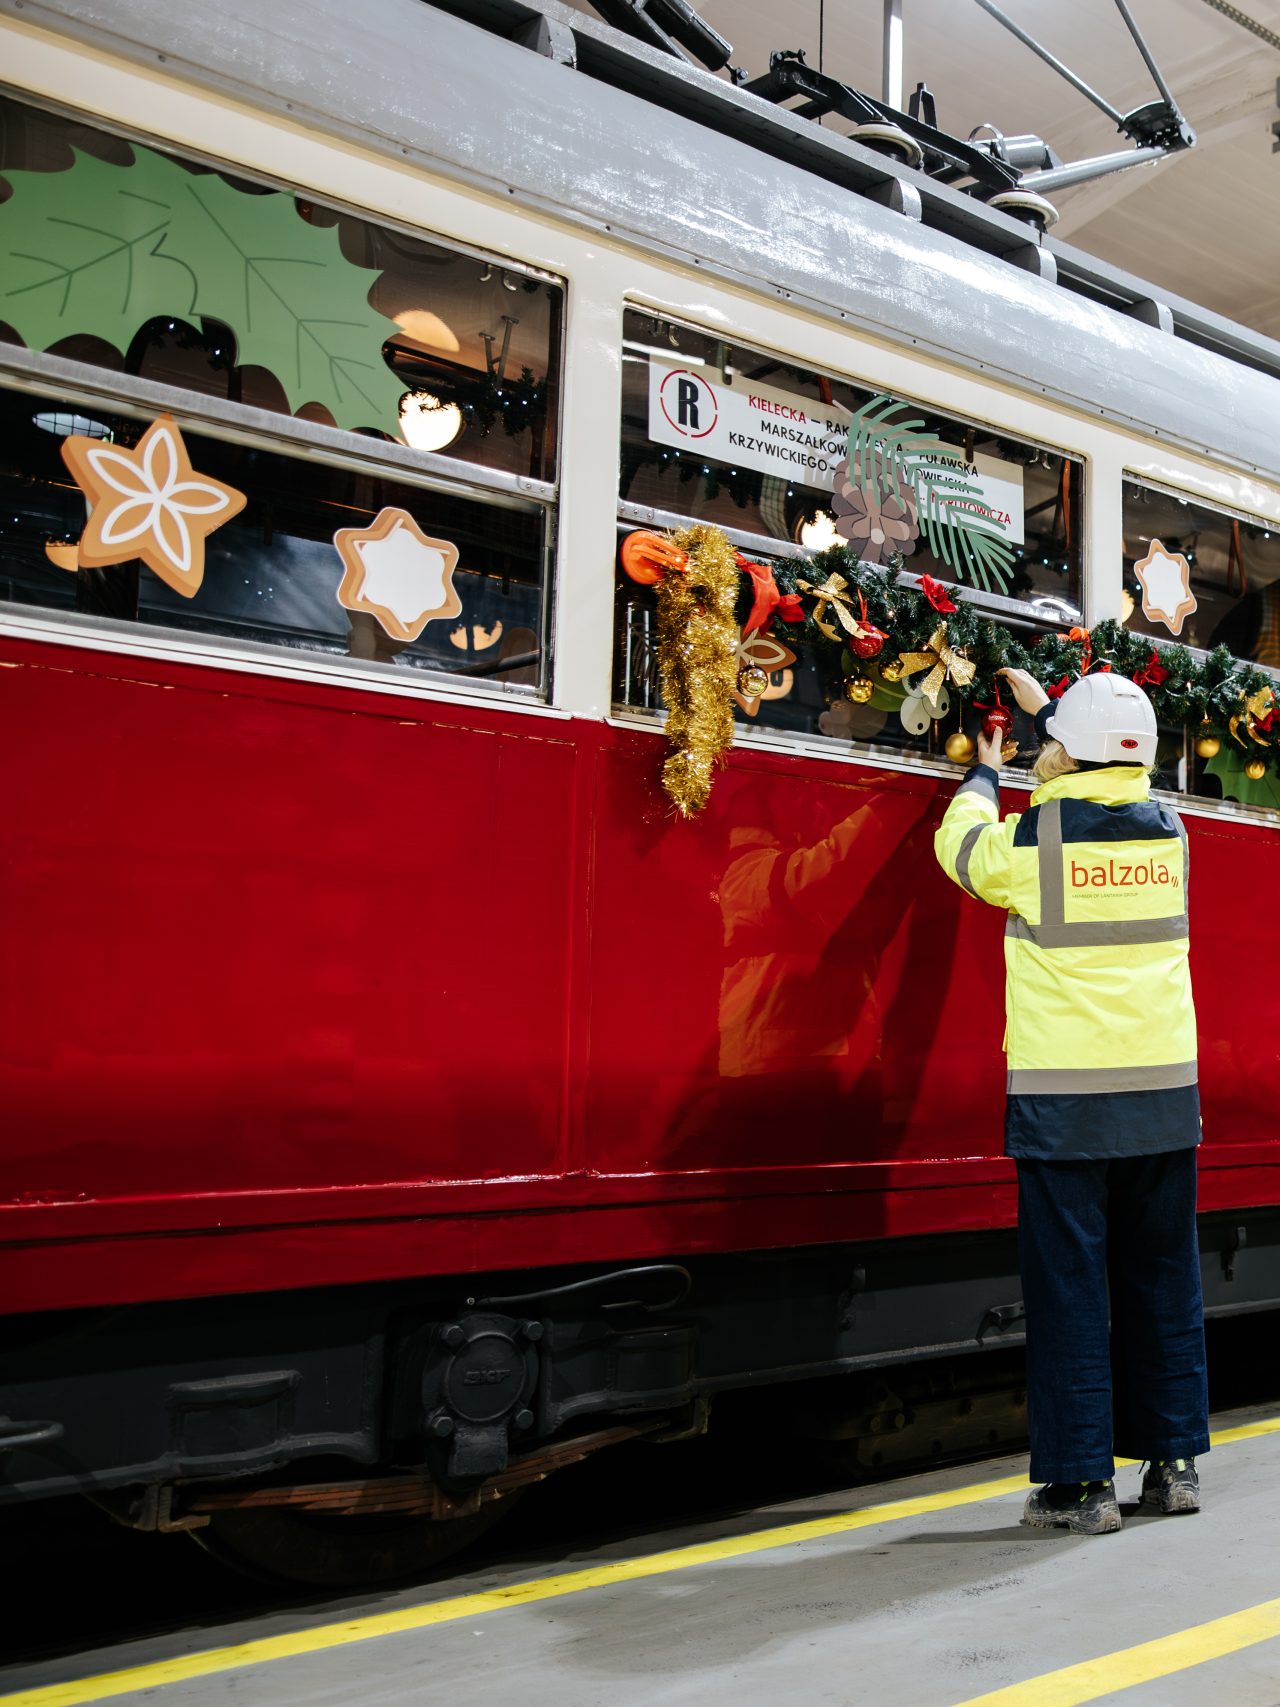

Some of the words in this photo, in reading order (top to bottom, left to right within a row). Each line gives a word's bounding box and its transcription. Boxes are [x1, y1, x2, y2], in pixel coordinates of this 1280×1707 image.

[678, 377, 700, 430] R
[748, 395, 807, 424] KIELECKA
[761, 420, 849, 458] MARSZAŁKOW
[1071, 858, 1169, 888] balzola
